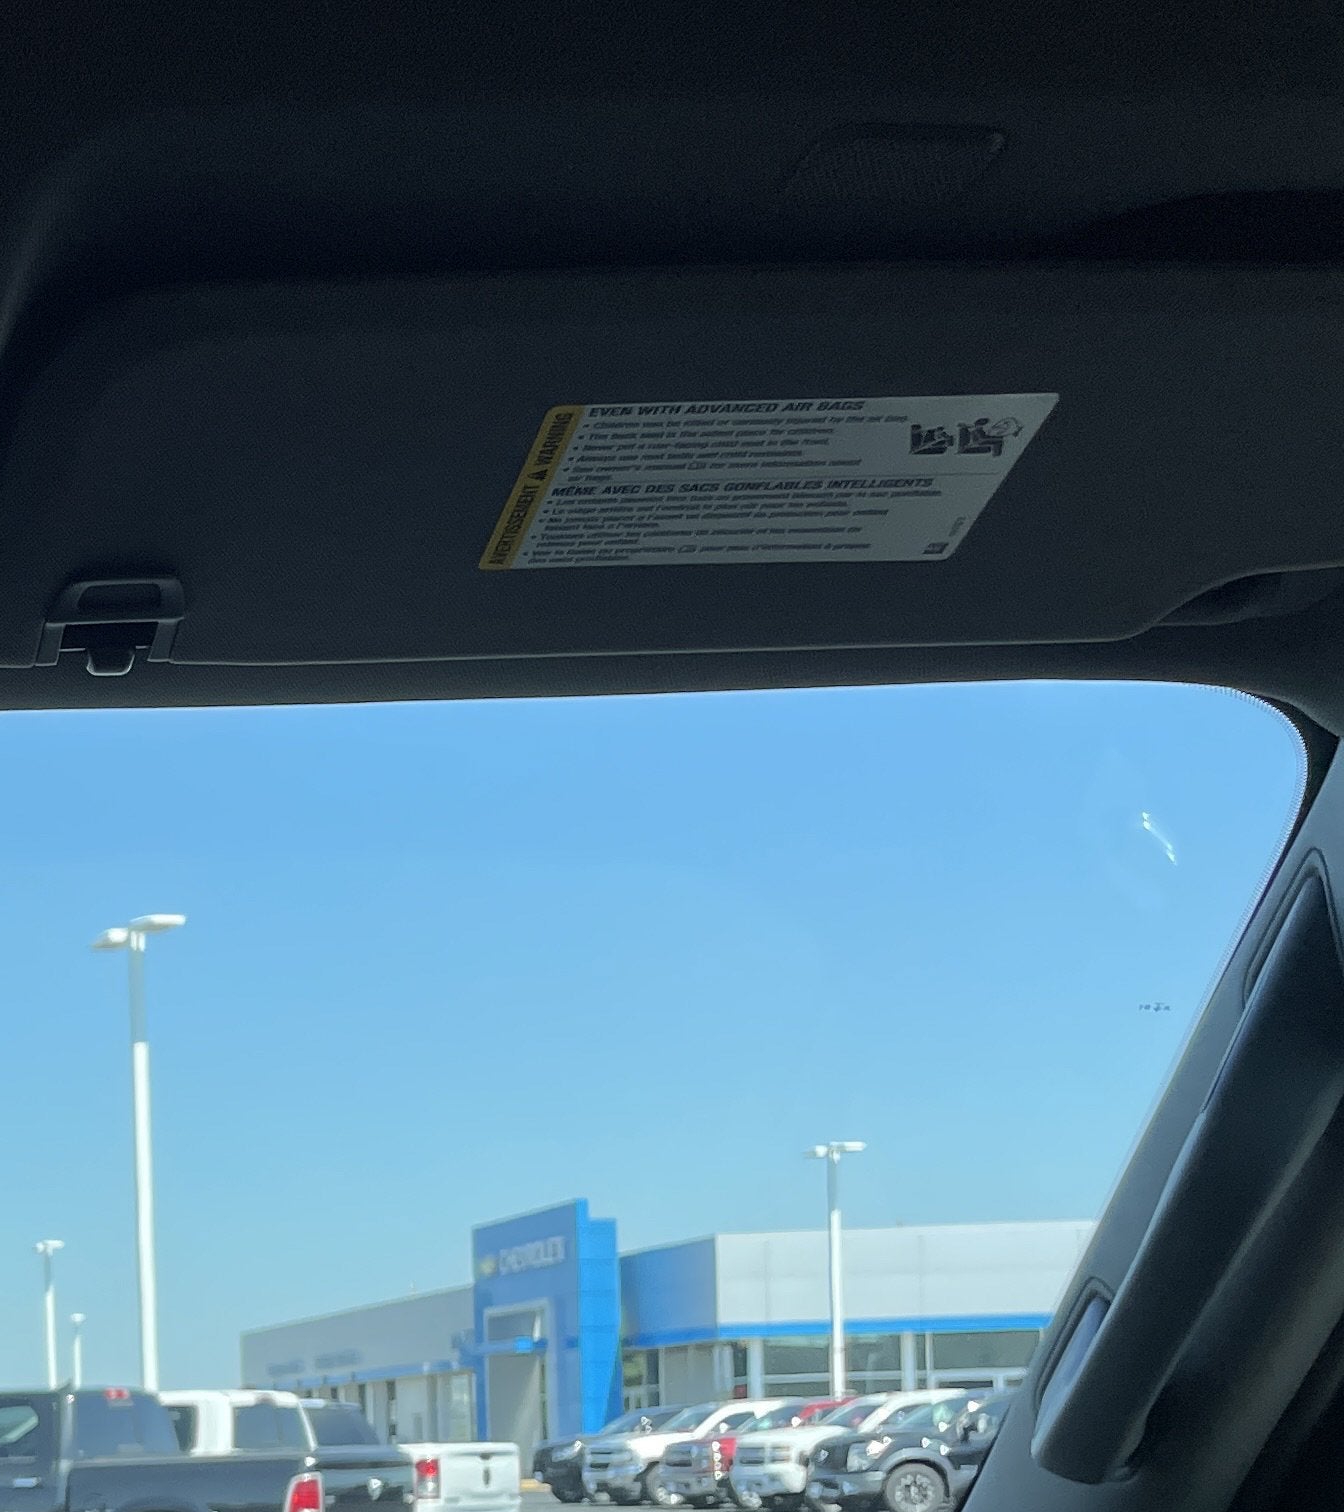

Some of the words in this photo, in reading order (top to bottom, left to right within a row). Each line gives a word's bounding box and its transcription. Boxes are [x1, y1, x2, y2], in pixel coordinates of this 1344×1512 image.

[589, 405, 632, 417] EVEN
[637, 404, 681, 416] WITH
[683, 402, 779, 415] ADVANCED
[781, 401, 814, 413] AIR
[816, 400, 866, 412] BAGS
[601, 483, 641, 495] AVEC
[645, 482, 675, 494] DES
[825, 477, 934, 490] INTELLIGENTS
